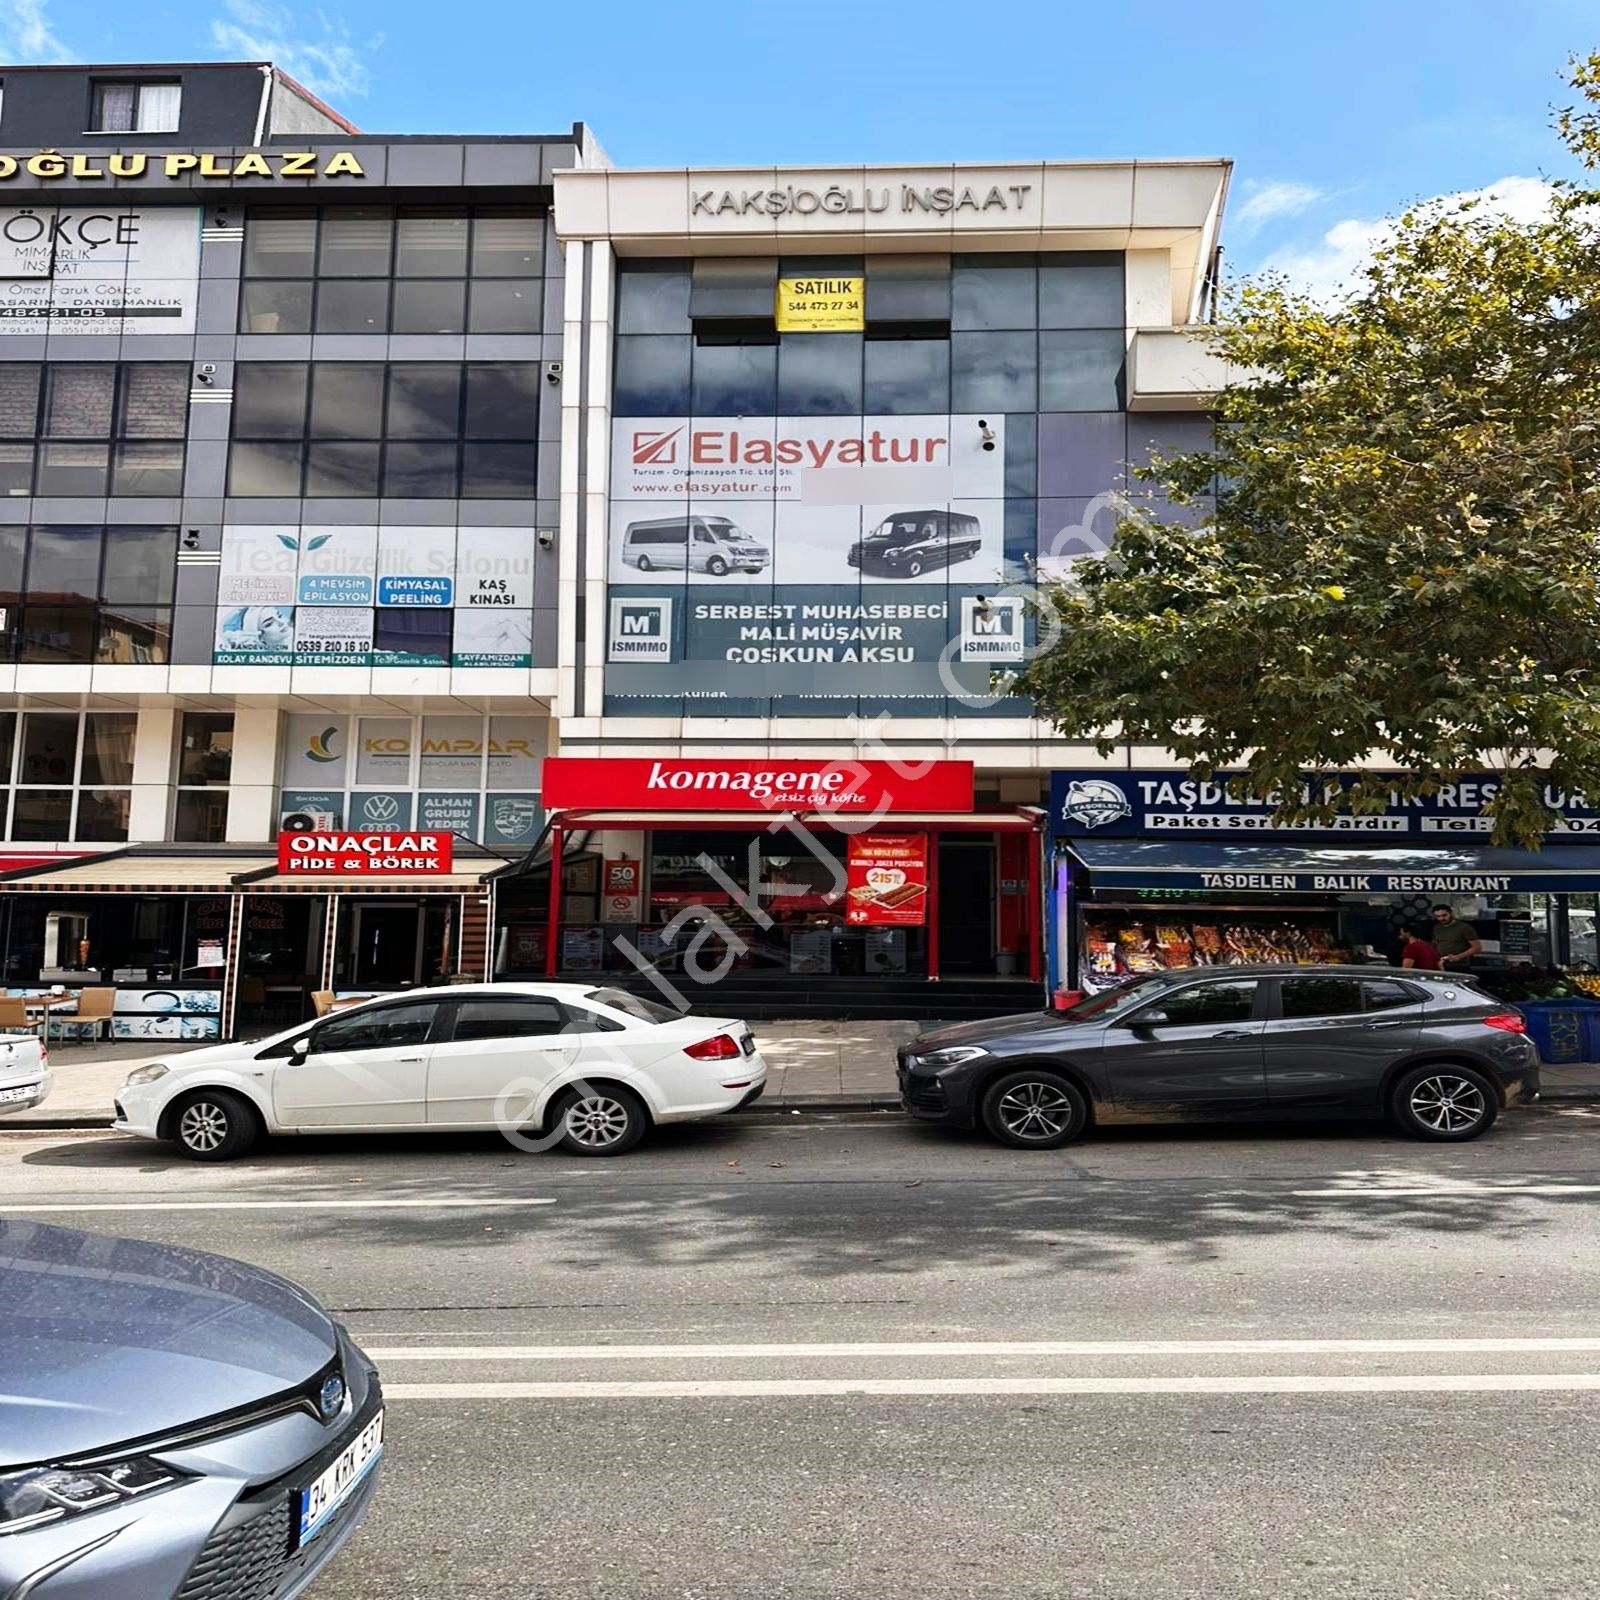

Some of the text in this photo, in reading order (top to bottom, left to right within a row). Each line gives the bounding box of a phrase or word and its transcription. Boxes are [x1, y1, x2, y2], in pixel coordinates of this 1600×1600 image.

[164, 152, 365, 178] PLAZA
[901, 182, 1031, 217] İNŞAAT
[794, 281, 852, 294] SATILIK
[788, 301, 859, 311] 544 473 27 34
[692, 430, 947, 468] Elasyatur
[632, 468, 665, 476] Turizm
[672, 468, 737, 477] Organizasyon
[632, 482, 792, 494] www.elasyatur.com
[225, 538, 530, 575] Tea Güzellik Salonu
[309, 579, 317, 588] 4
[385, 578, 448, 590] KİMYASAL
[479, 579, 507, 593] KAŞ
[389, 591, 443, 604] PEELİNG
[469, 594, 516, 605] KINASI
[694, 601, 949, 619] SERBEST MUHASEBECİ
[740, 624, 903, 645] MALİ MÜŞAVİR
[296, 641, 370, 652] 0539 210 16 10
[612, 639, 667, 653] İSMMMO
[217, 655, 245, 664] KOLAY
[248, 655, 293, 664] RANDEVU
[295, 653, 366, 664] SİTEMİZDEN
[840, 646, 915, 663] AKSU
[364, 739, 536, 758] KOMPAR
[647, 762, 844, 799] komagene
[424, 798, 473, 807] ALMAN
[774, 793, 805, 803] etsiz
[829, 792, 866, 804] köfte
[424, 809, 471, 818] GRUBU
[425, 819, 470, 829] YEDEK
[1152, 815, 1221, 828] Paket
[1429, 818, 1487, 831] Tel:
[290, 835, 440, 857] ONAÇLAR
[290, 855, 440, 870] PİDE & BÖREK
[610, 866, 635, 880] 50
[1313, 875, 1371, 890] BALIK
[1387, 876, 1512, 891] RESTAURANT
[310, 1477, 327, 1519] 34
